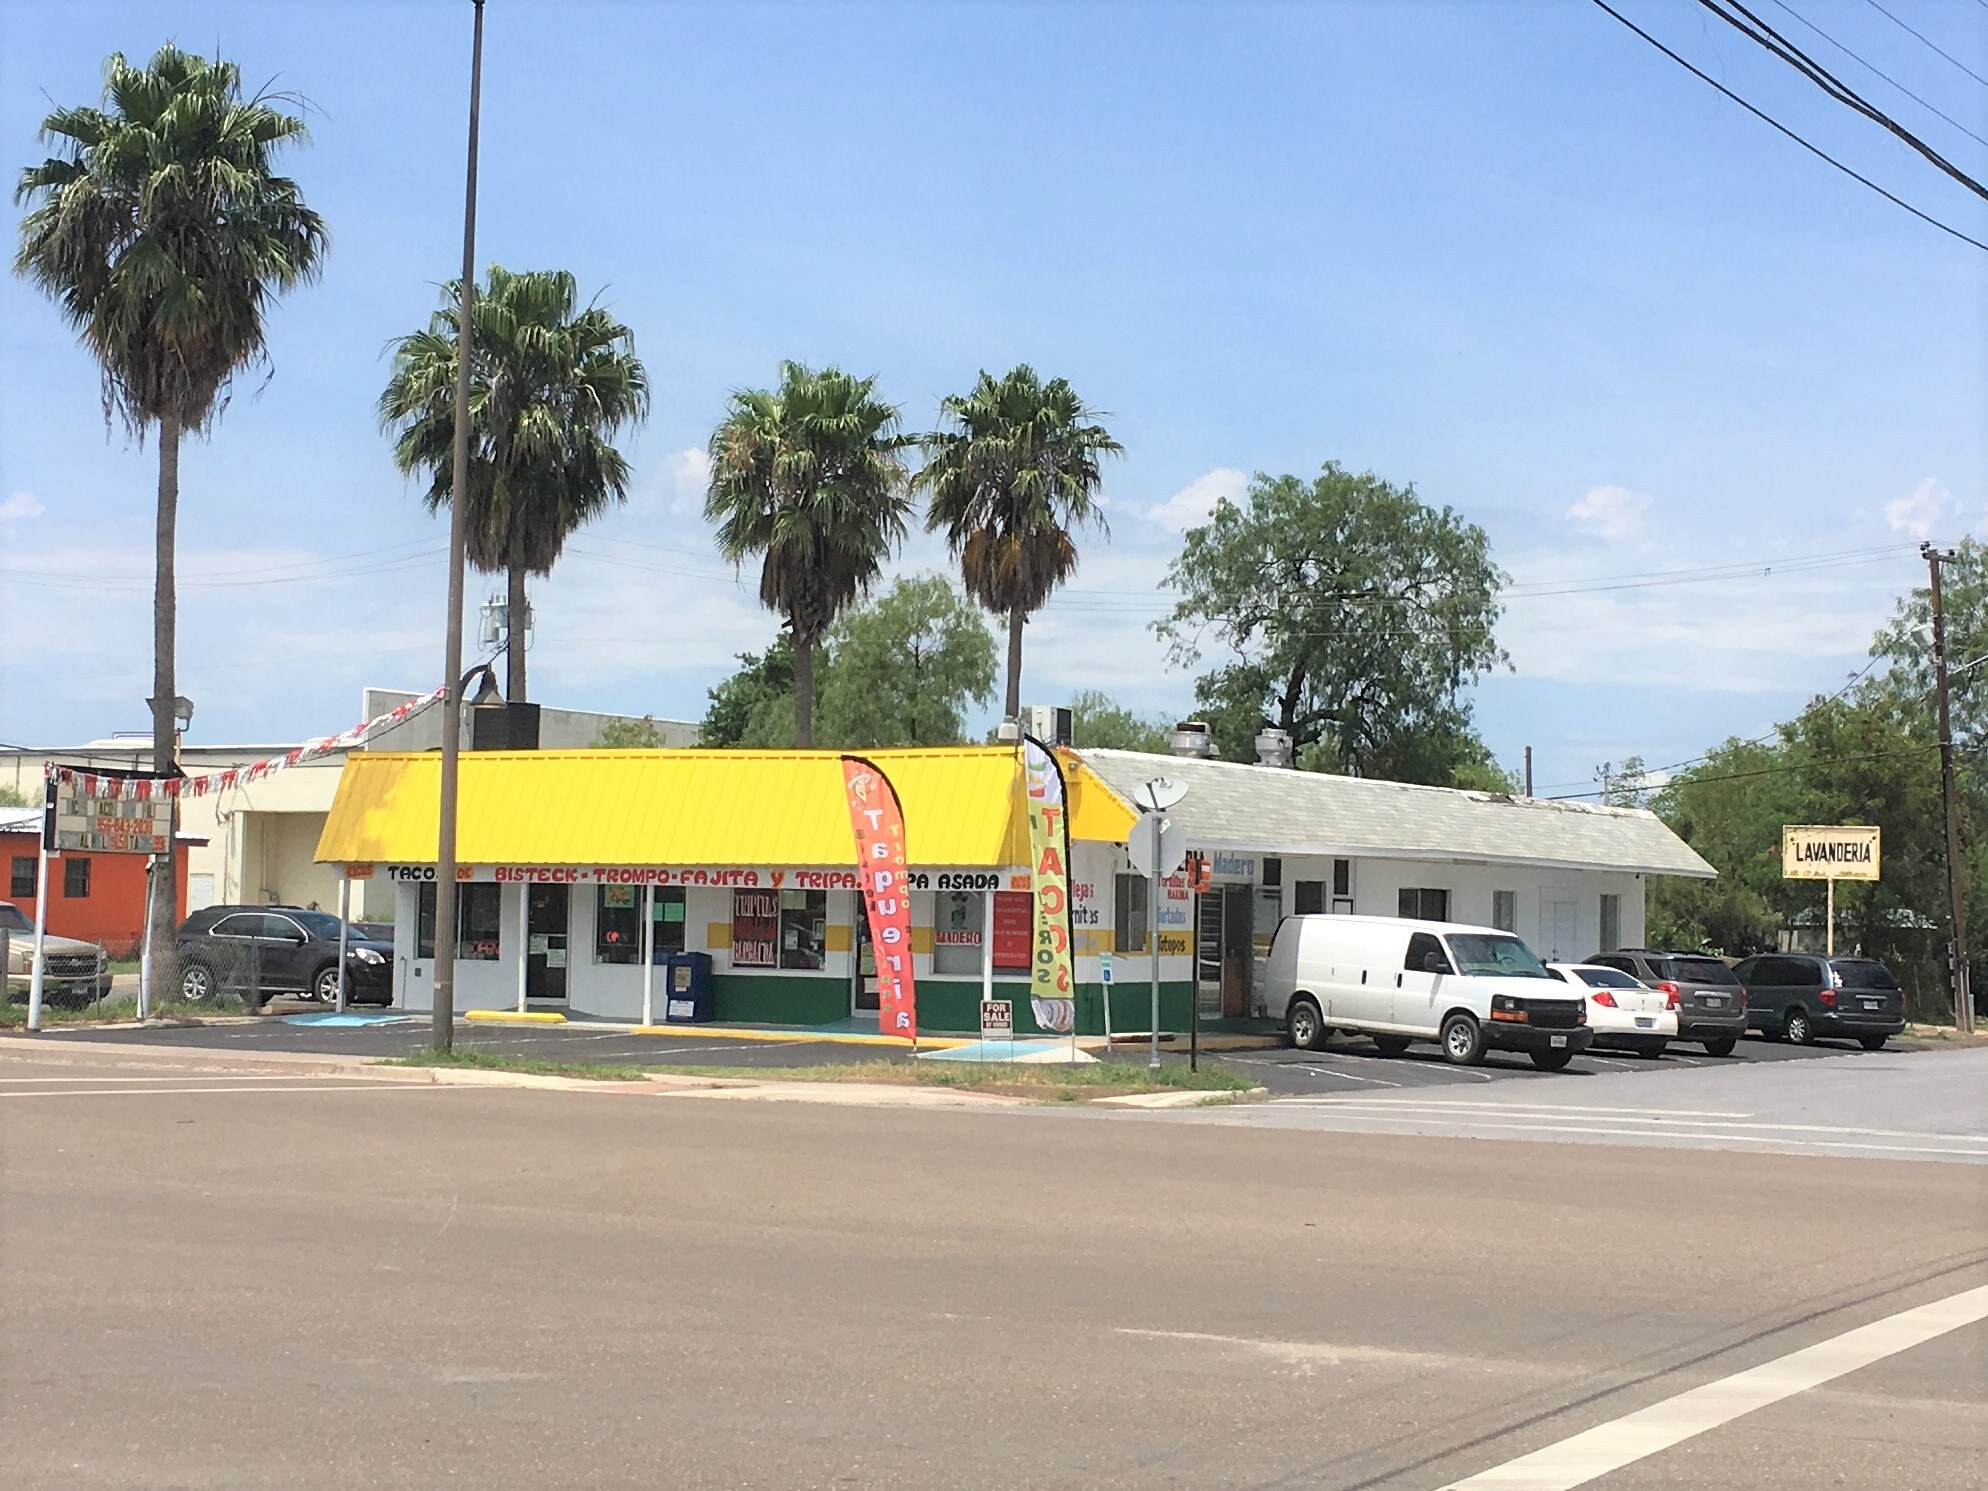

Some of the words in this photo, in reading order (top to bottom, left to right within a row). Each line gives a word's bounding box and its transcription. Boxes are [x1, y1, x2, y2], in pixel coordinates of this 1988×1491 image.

[1795, 842, 1871, 862] LAVANDERIA
[387, 866, 438, 880] TACO
[494, 866, 577, 883] BISTECK
[592, 868, 669, 884] TROMPO
[680, 868, 758, 886] FAJITA
[938, 874, 1000, 889] ASADA
[936, 932, 982, 945] MADERO
[986, 1004, 1006, 1013] FOR
[983, 1012, 1010, 1022] SALE
